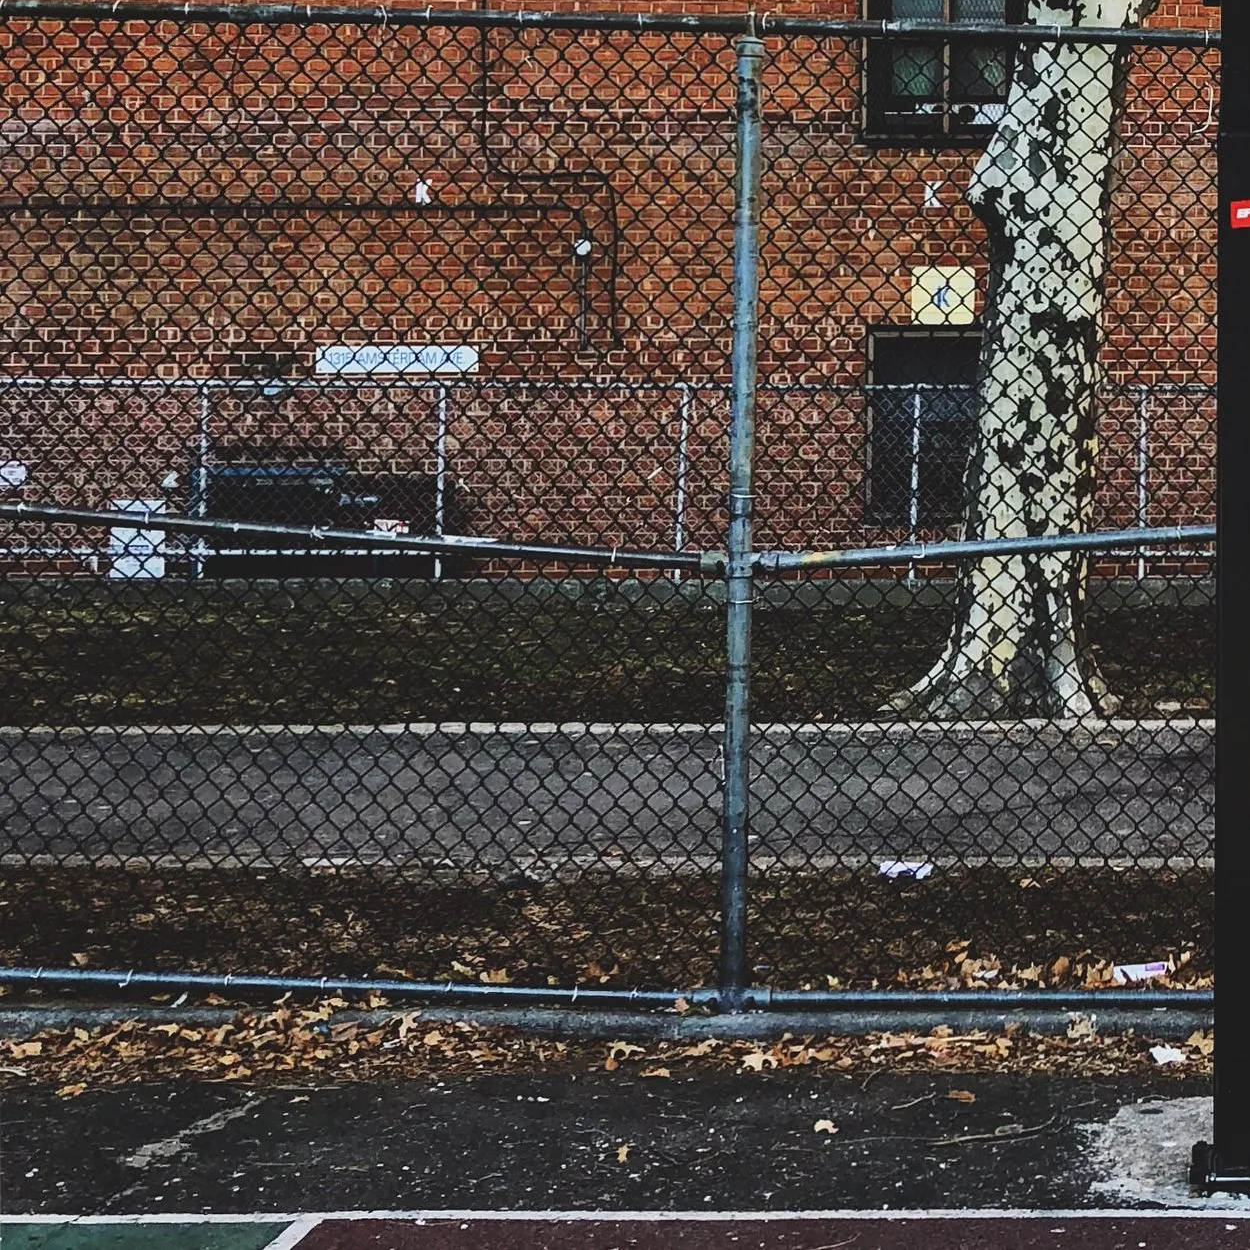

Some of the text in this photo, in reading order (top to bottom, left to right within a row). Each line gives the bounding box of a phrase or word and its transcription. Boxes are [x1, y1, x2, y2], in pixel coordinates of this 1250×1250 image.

[415, 178, 433, 204] K
[924, 180, 942, 207] K
[935, 285, 951, 308] K
